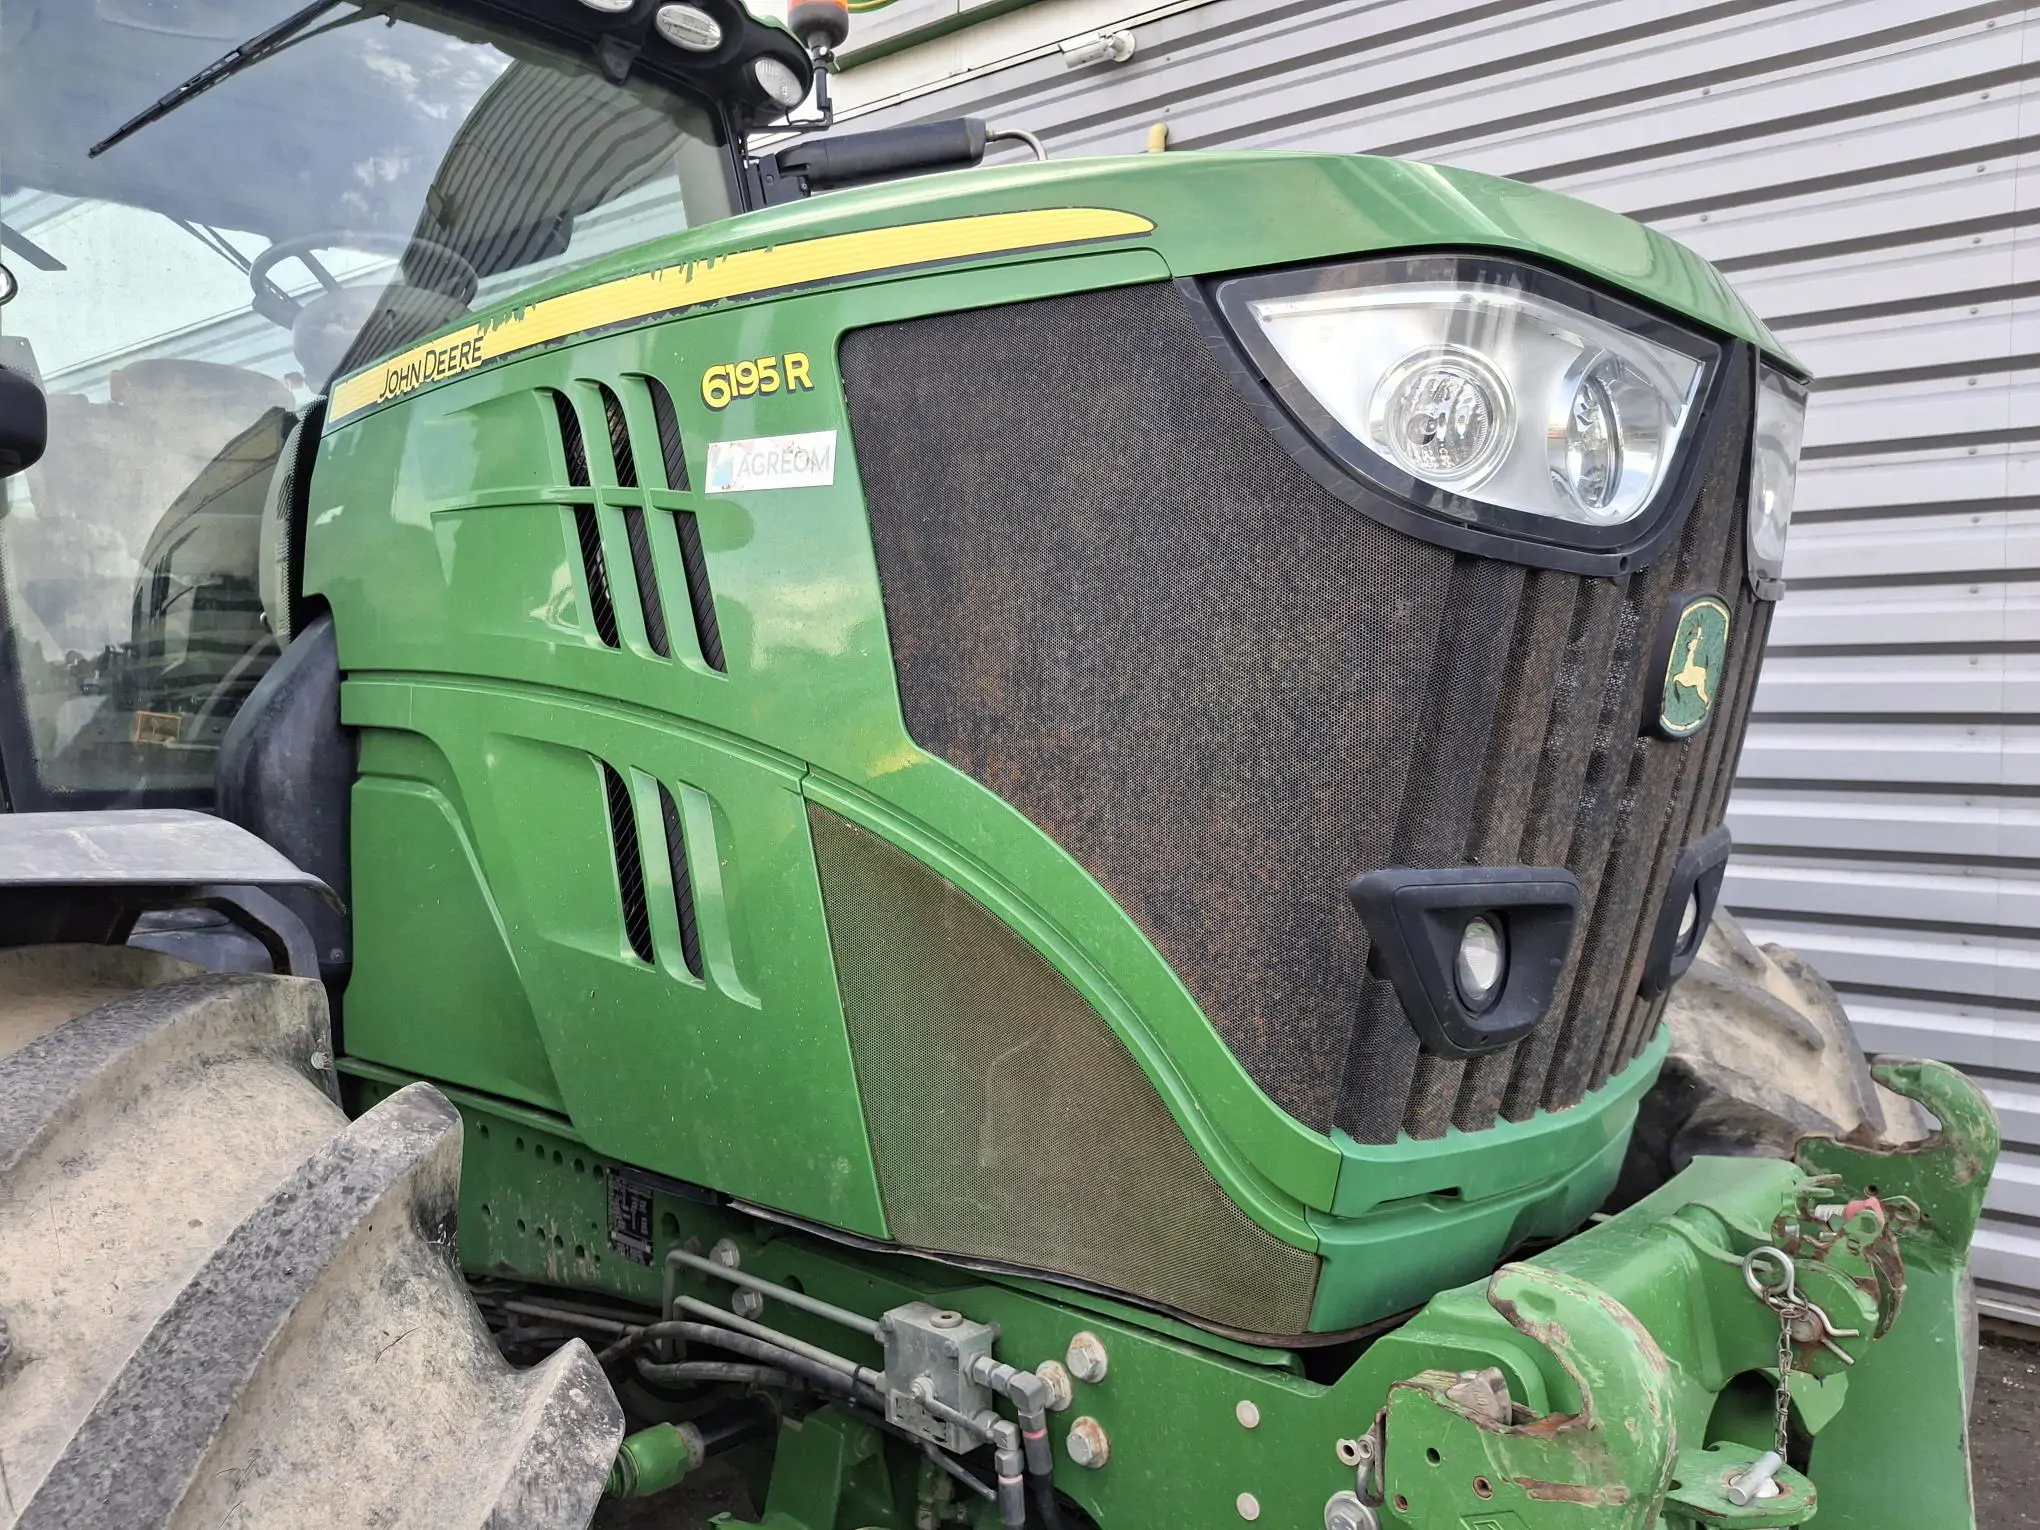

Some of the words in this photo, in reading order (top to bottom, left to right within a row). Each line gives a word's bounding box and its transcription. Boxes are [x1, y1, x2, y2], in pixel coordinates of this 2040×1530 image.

[379, 359, 422, 399] JOHN
[423, 335, 484, 380] DEERE
[701, 356, 780, 410] 6195
[783, 352, 814, 392] R
